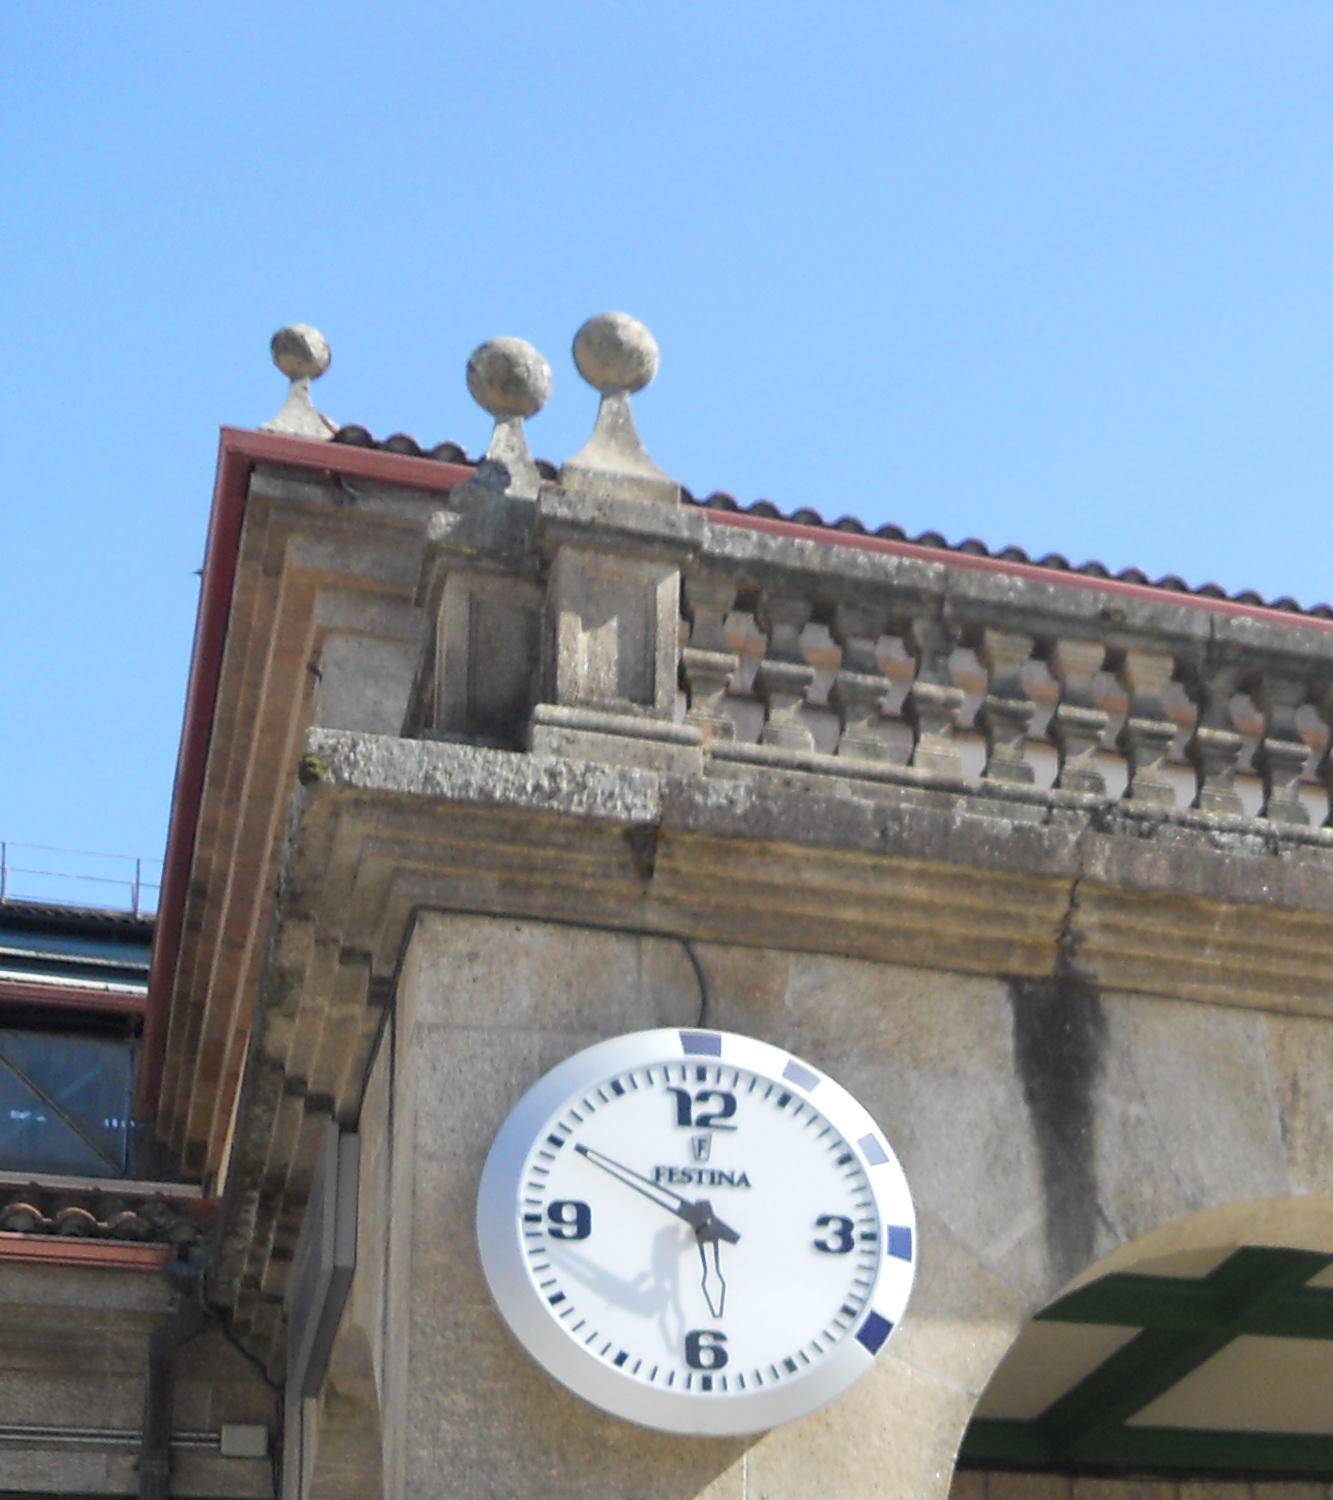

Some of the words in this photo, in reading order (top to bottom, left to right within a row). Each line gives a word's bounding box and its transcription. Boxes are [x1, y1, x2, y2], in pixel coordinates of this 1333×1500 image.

[667, 1087, 737, 1130] 12
[654, 1166, 752, 1188] FESTINA
[547, 1200, 592, 1240] 9
[814, 1214, 855, 1254] 3
[684, 1329, 729, 1370] 6
